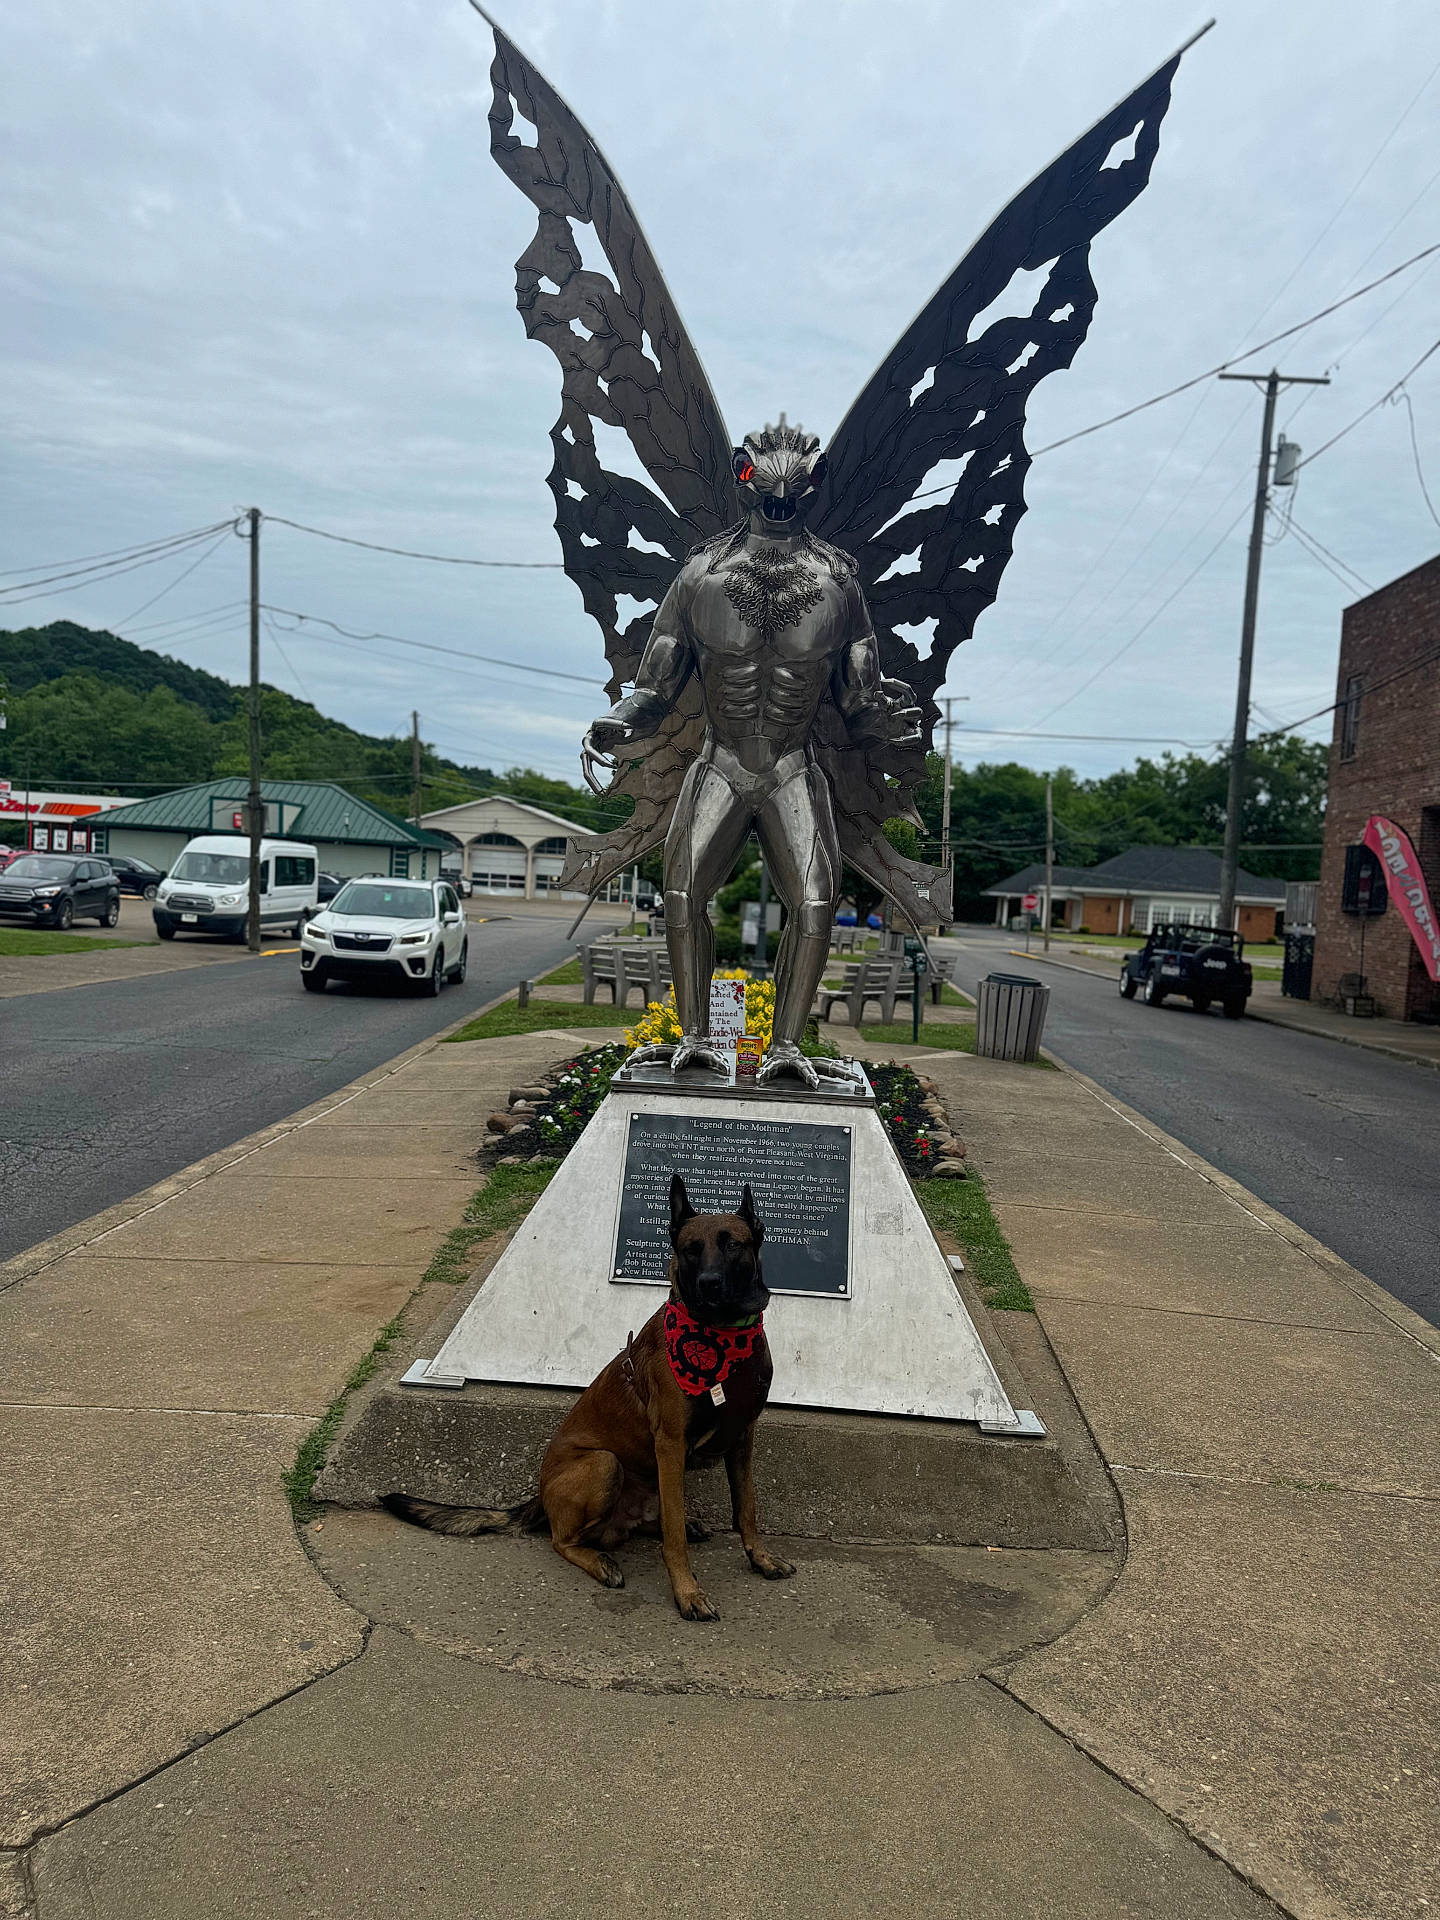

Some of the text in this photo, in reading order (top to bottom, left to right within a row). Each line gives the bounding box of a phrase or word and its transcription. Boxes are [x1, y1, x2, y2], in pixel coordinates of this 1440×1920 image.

[0, 799, 40, 814] Zone
[689, 1119, 793, 1133] "Legend of the Mothman"
[632, 1140, 651, 1148] drove
[652, 1141, 667, 1149] into
[668, 1142, 679, 1150] the
[680, 1142, 698, 1151] TNT
[747, 1147, 765, 1155] Point
[797, 1151, 814, 1159] West
[640, 1131, 651, 1139] On
[694, 1135, 712, 1143] night
[713, 1135, 720, 1143] in
[723, 1136, 757, 1145] November
[777, 1140, 790, 1148] two
[791, 1142, 813, 1150] young
[814, 1143, 840, 1152] couples
[671, 1151, 690, 1160] when
[692, 1153, 707, 1161] they
[709, 1154, 738, 1163] realized
[739, 1156, 754, 1165] they
[630, 1173, 664, 1182] mysteries
[725, 1179, 736, 1187] the
[772, 1182, 798, 1191] Legacy
[825, 1185, 831, 1193] It
[832, 1186, 845, 1194] has
[640, 1163, 659, 1172] What
[660, 1165, 675, 1174] they
[692, 1167, 706, 1175] that
[707, 1168, 725, 1177] night
[726, 1169, 739, 1177] has
[739, 1171, 765, 1179] evolved
[767, 1172, 782, 1180] into
[806, 1175, 818, 1183] the
[819, 1177, 838, 1185] great
[626, 1183, 649, 1191] grown
[651, 1183, 666, 1191] into
[718, 1188, 742, 1196] known
[783, 1193, 803, 1201] world
[805, 1194, 814, 1203] by
[815, 1195, 845, 1203] millions
[643, 1193, 670, 1201] curious
[694, 1196, 718, 1206] asking
[757, 1200, 776, 1208] What
[777, 1202, 798, 1211] really
[800, 1203, 838, 1212] happened?
[647, 1202, 666, 1211] What
[700, 1207, 724, 1215] people
[765, 1211, 782, 1219] been
[802, 1213, 825, 1222] since?
[640, 1216, 645, 1224] It
[645, 1217, 661, 1225] still
[773, 1227, 802, 1235] mystery
[803, 1227, 829, 1237] behind
[626, 1238, 661, 1248] Sculpture
[624, 1258, 663, 1268] Bob Roach
[625, 1250, 648, 1259] Artist
[623, 1267, 640, 1275] New
